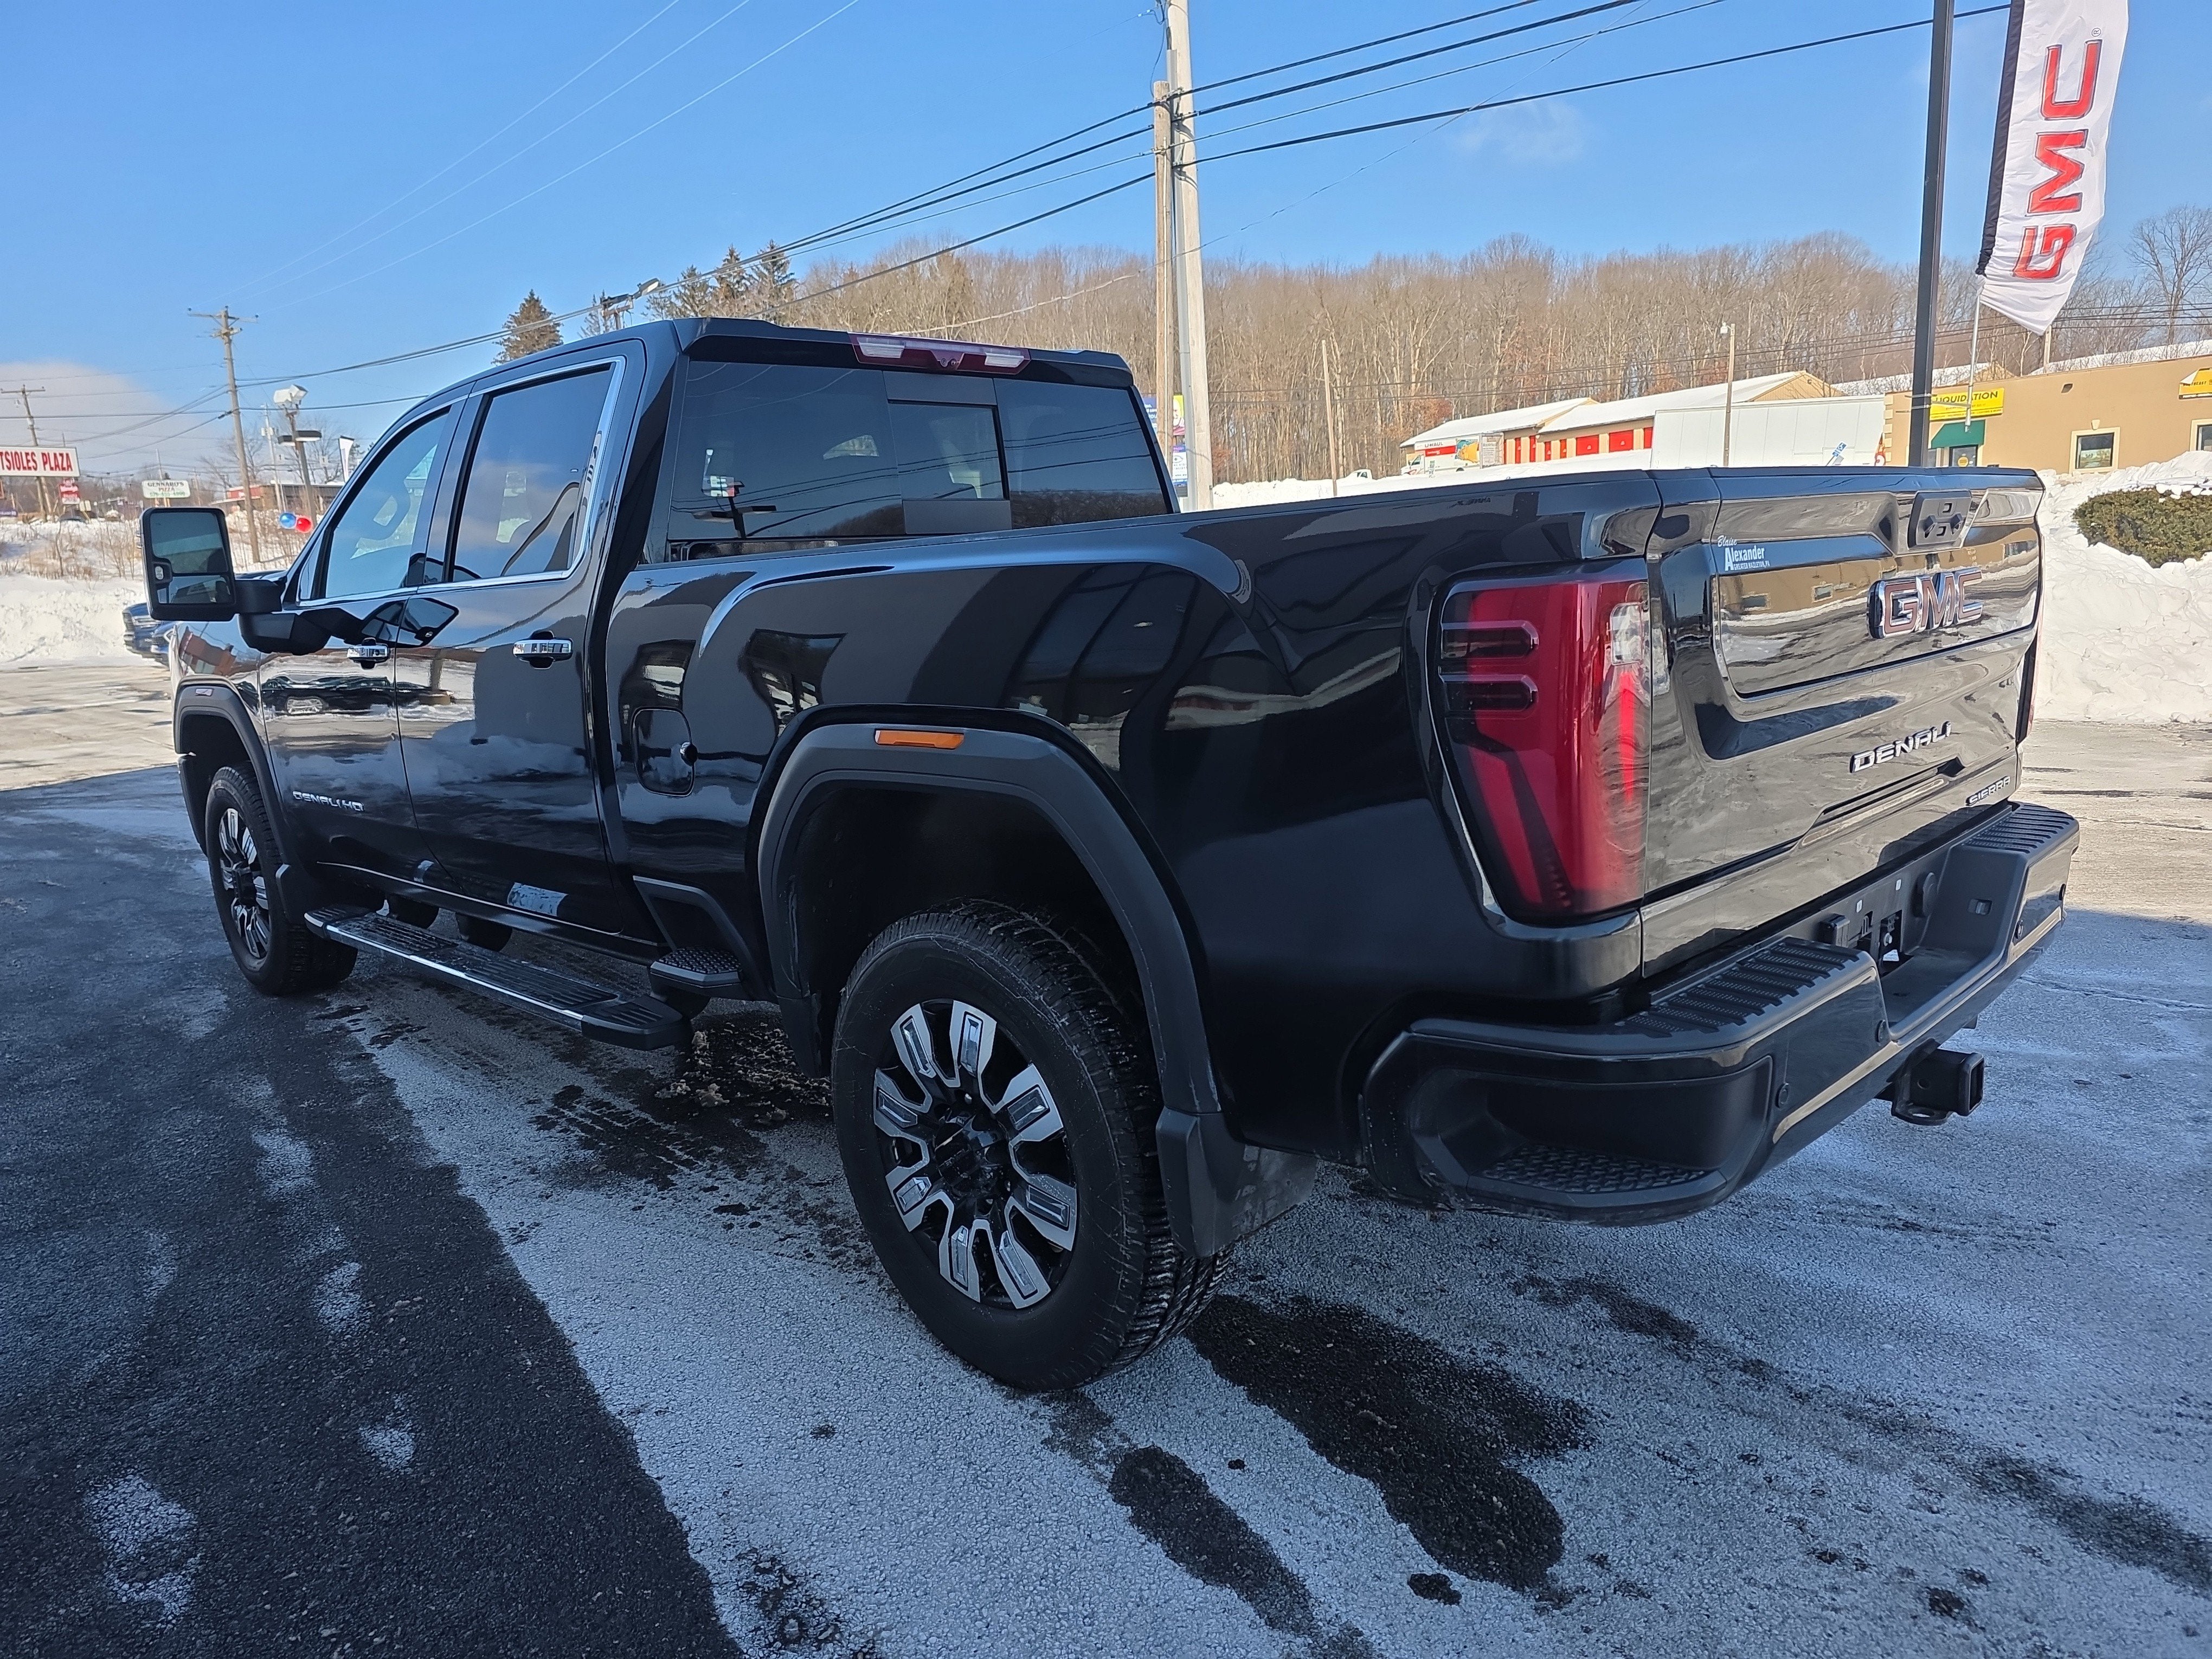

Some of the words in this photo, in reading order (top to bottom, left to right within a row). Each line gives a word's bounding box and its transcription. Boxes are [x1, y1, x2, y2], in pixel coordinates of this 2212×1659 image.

[2012, 40, 2102, 280] GMC
[41, 452, 73, 471] PLAZA
[1718, 535, 1737, 547] Blaise
[1725, 545, 1765, 571] Alexander
[1876, 568, 1983, 638] GMC
[1849, 721, 1952, 773] DENALI
[292, 791, 342, 808] DENALI
[342, 800, 365, 812] HD
[1965, 776, 2011, 806] SIERRA
